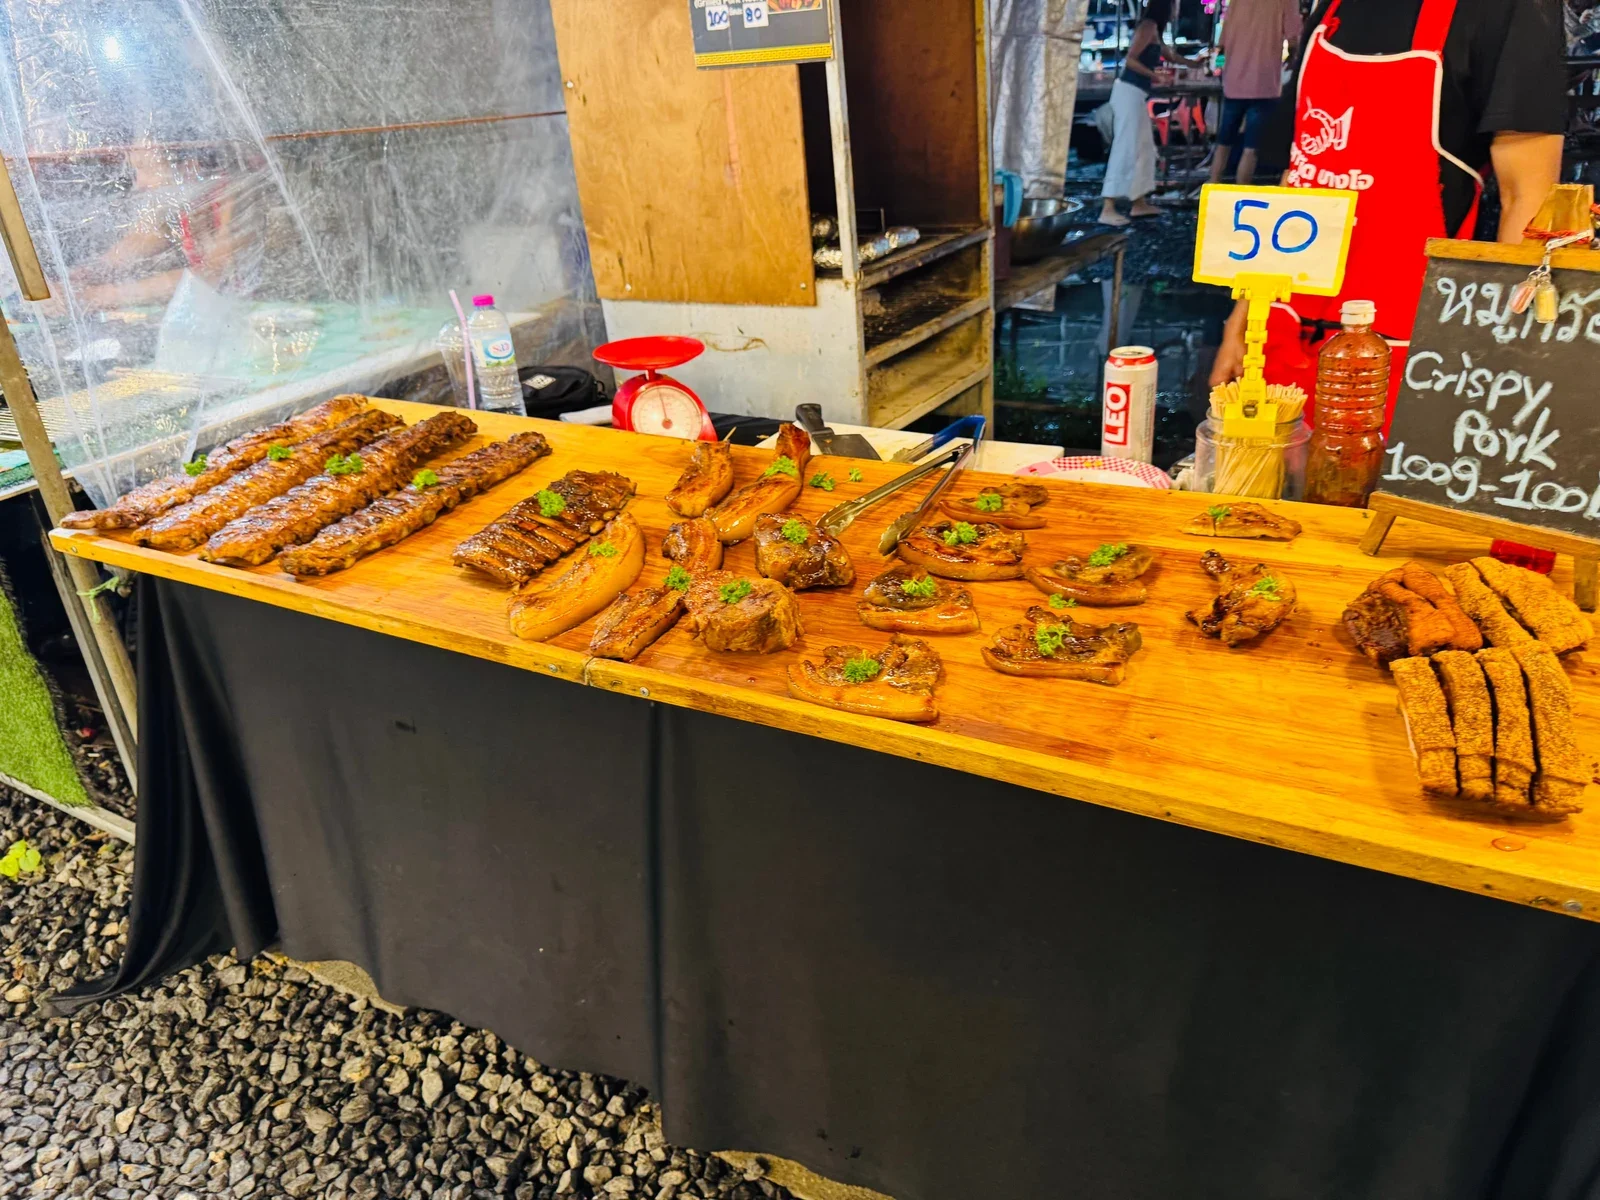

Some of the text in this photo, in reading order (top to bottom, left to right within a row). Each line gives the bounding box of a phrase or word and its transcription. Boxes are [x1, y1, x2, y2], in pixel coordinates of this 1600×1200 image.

[745, 7, 762, 22] 80
[1228, 199, 1319, 261] 50
[1104, 386, 1127, 443] LEO
[1405, 351, 1553, 425] Crispy
[1453, 407, 1560, 470] Pork
